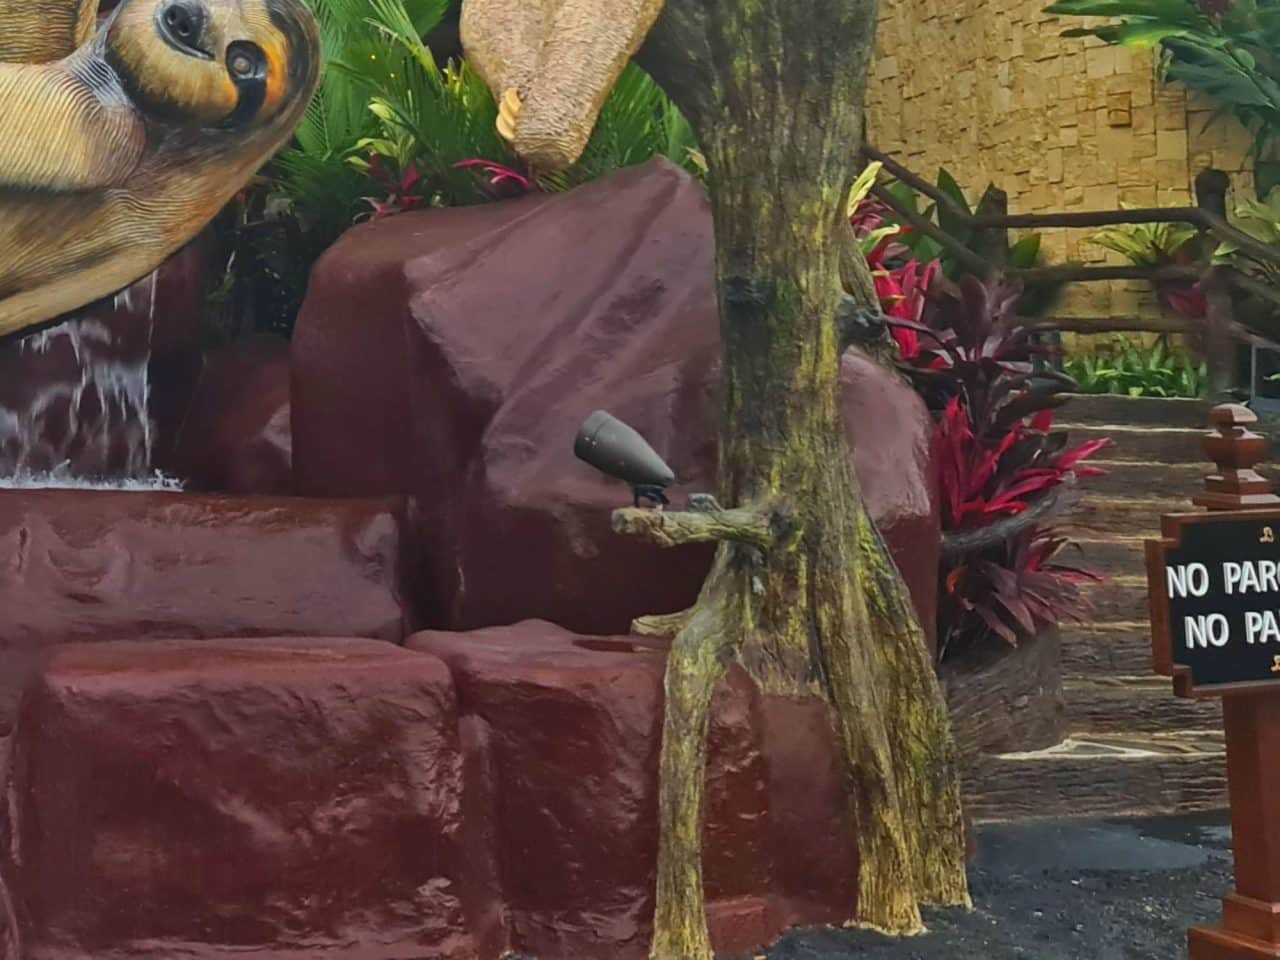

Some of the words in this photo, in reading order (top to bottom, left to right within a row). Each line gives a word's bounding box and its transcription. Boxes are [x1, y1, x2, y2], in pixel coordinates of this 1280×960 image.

[1166, 563, 1209, 599] NO
[1223, 560, 1280, 594] PAR
[1185, 613, 1229, 648] NO
[1244, 609, 1280, 645] PA
